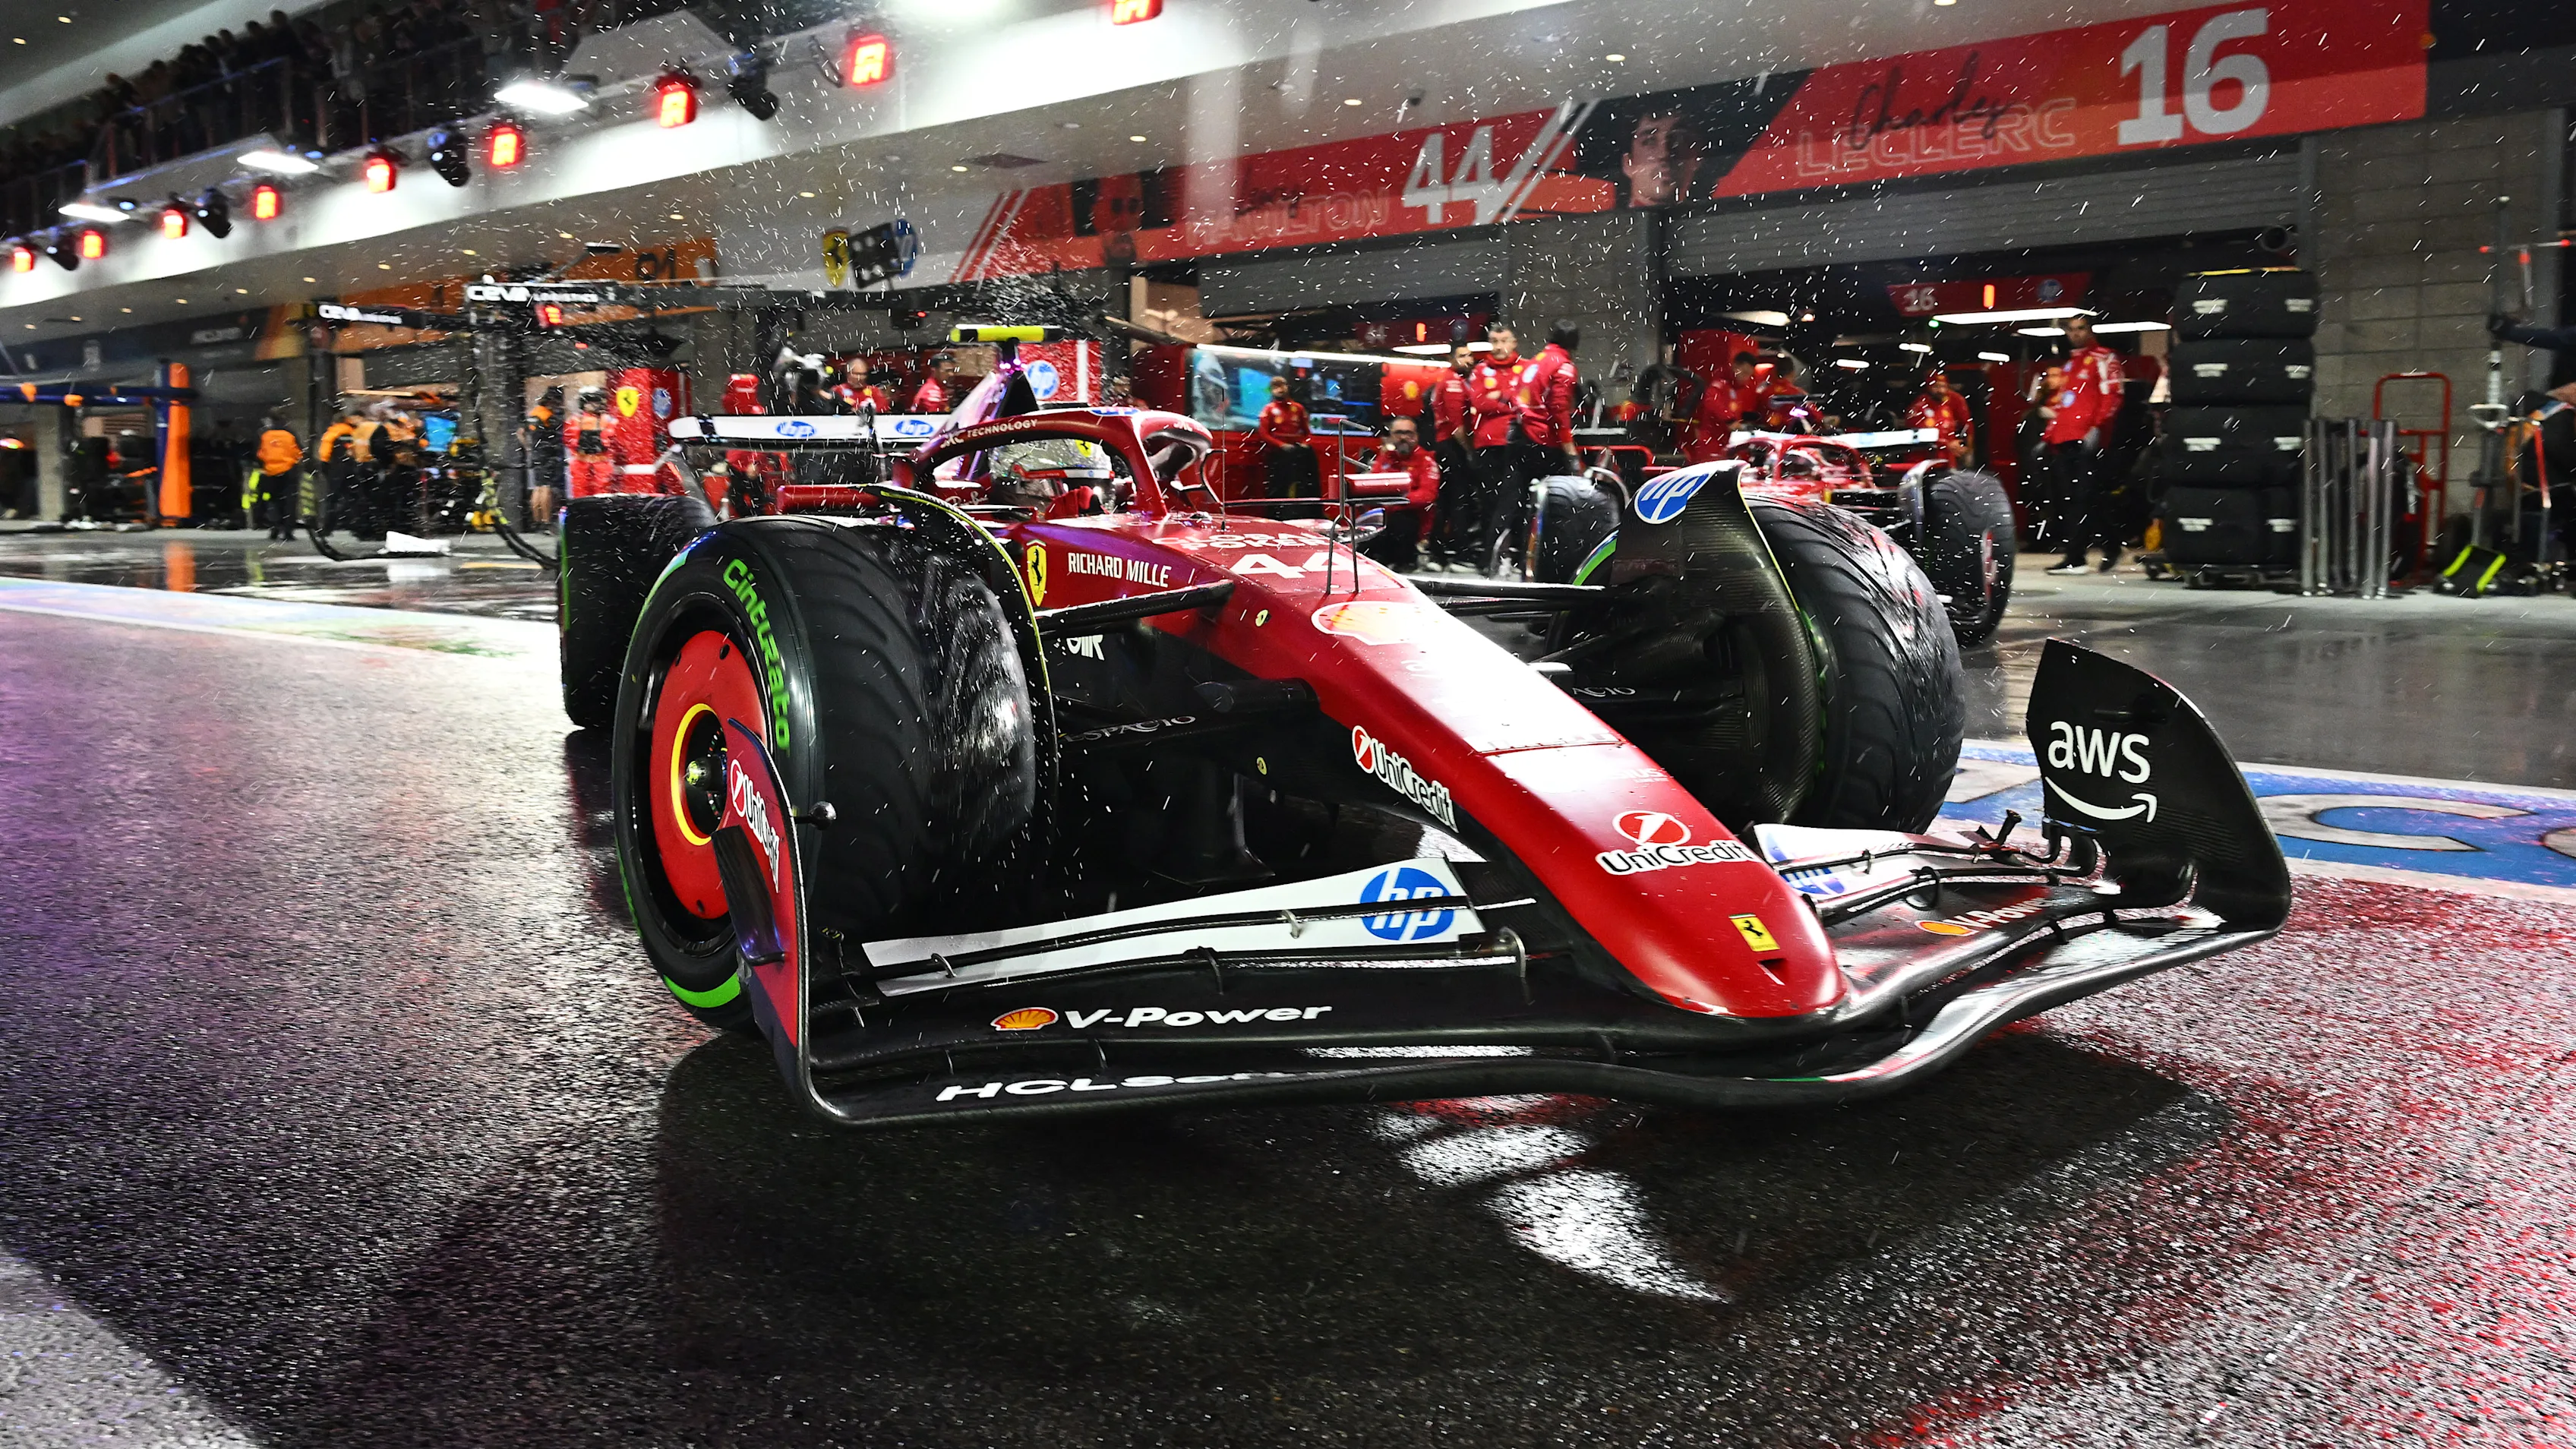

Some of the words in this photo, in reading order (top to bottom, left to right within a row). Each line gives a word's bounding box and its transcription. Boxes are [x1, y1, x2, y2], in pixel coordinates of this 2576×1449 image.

[2117, 8, 2271, 145] 16
[1798, 98, 2077, 177] LECLERC
[1401, 125, 1511, 226] 44
[1904, 287, 1936, 312] 16
[779, 420, 814, 438] hp
[898, 420, 932, 437] hp
[967, 418, 1037, 438] TECHNOLOGY
[1153, 533, 1329, 545] GLOBAL
[1182, 538, 1329, 551] POKER
[1068, 552, 1122, 579] RICHARD
[1125, 559, 1173, 588] MILLE
[1229, 552, 1376, 579] 44
[723, 558, 790, 749] Cinturato
[2048, 721, 2151, 784] aws
[1372, 739, 1457, 831] UniCredit
[1601, 840, 1754, 873] UniCredit
[1372, 867, 1444, 940] hp
[1065, 1005, 1332, 1029] V-Power
